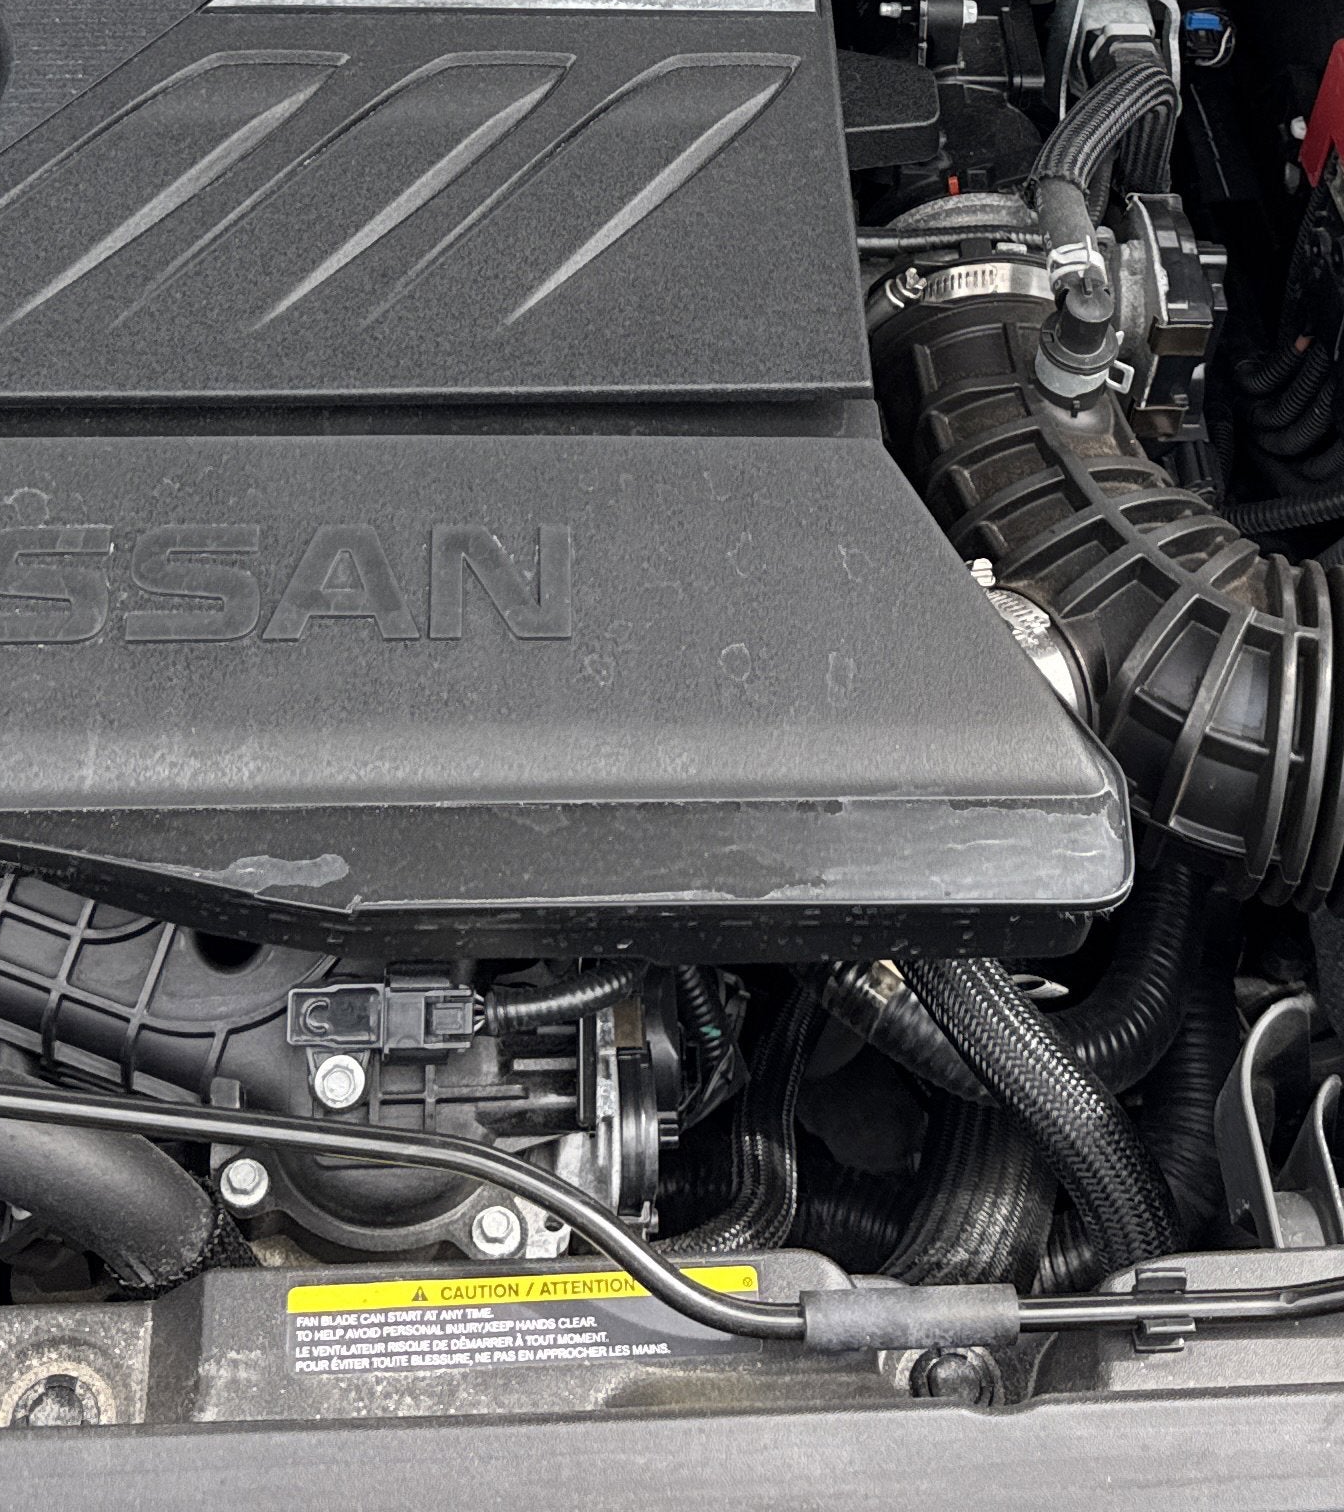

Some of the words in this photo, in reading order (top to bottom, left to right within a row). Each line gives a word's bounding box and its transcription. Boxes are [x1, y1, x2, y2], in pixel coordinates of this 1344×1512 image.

[440, 1283, 520, 1300] CAUTION
[526, 1282, 535, 1296] /
[540, 1278, 636, 1296] ATTENTION
[296, 1316, 319, 1327] FAN
[320, 1313, 358, 1327] BLADE
[360, 1312, 386, 1325] CAN
[387, 1311, 422, 1323] START
[424, 1310, 439, 1321] AT
[440, 1309, 464, 1321] ANY
[465, 1307, 494, 1320] TIME.
[296, 1330, 312, 1342] TO
[315, 1328, 344, 1341] HELP
[344, 1326, 382, 1339] AVOID
[383, 1324, 444, 1337] PERSONAL
[516, 1318, 556, 1331] HANDS
[558, 1316, 598, 1329] CLEAR.
[295, 1345, 311, 1358] LE
[312, 1342, 386, 1357] VENTILATEUR
[387, 1339, 431, 1353] RISQUE
[432, 1338, 449, 1351] DE
[451, 1335, 513, 1350] DÉMARRER
[515, 1333, 524, 1347] À
[525, 1334, 558, 1347] TOUT
[558, 1331, 609, 1345] MOMENT.
[295, 1360, 330, 1373] POUR
[331, 1356, 371, 1371] ÉVITER
[372, 1355, 409, 1369] TOUTE
[411, 1352, 473, 1367] BLESSURE,
[475, 1351, 492, 1364] NE
[493, 1350, 517, 1363] PAS
[518, 1349, 534, 1362] EN
[536, 1345, 608, 1361] APPROCHER
[609, 1344, 631, 1356] LES
[632, 1342, 671, 1356] MAINS.
